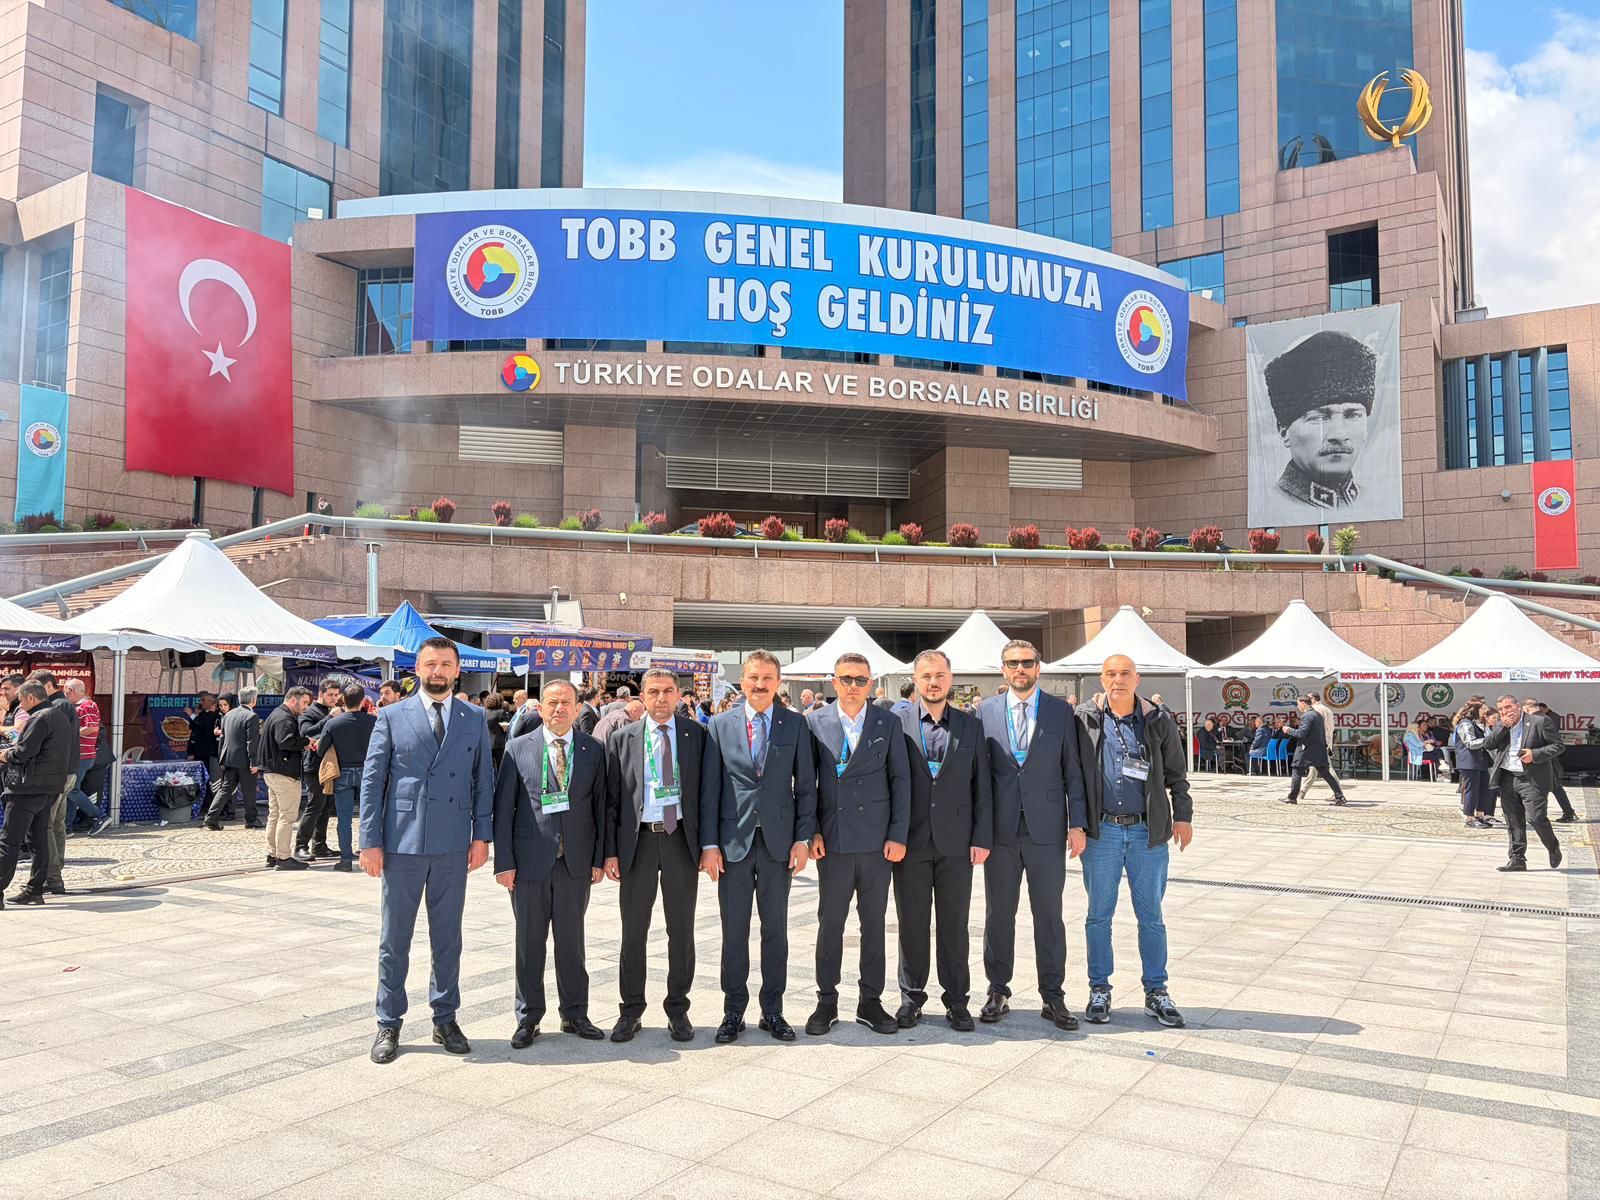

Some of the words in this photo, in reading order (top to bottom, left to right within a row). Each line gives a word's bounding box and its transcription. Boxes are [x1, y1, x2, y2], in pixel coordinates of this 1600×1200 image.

[451, 232, 480, 264] ODALAR
[482, 228, 495, 236] VE
[499, 229, 535, 267] BORSALAR
[560, 217, 677, 261] TOBB
[704, 220, 834, 272] GENEL
[858, 233, 1103, 312] KURULUMUZA
[480, 307, 505, 316] TOBB
[706, 276, 793, 338] HOŞ
[817, 284, 997, 346] GELDİNİZ
[1119, 294, 1138, 319] ODALAR
[1137, 362, 1155, 371] TOBB
[554, 359, 684, 387] TÜRKİYE
[692, 366, 814, 393] ODALAR
[823, 373, 859, 396] VE
[869, 376, 1010, 410] BORSALAR
[1018, 389, 1099, 421] BİRLİĞİ
[460, 658, 479, 668] İCARET
[479, 659, 496, 669] ODASI
[1384, 670, 1421, 680] TİCARET
[1424, 671, 1436, 680] VE
[1473, 671, 1503, 680] ODASI
[1540, 670, 1573, 680] HATAY
